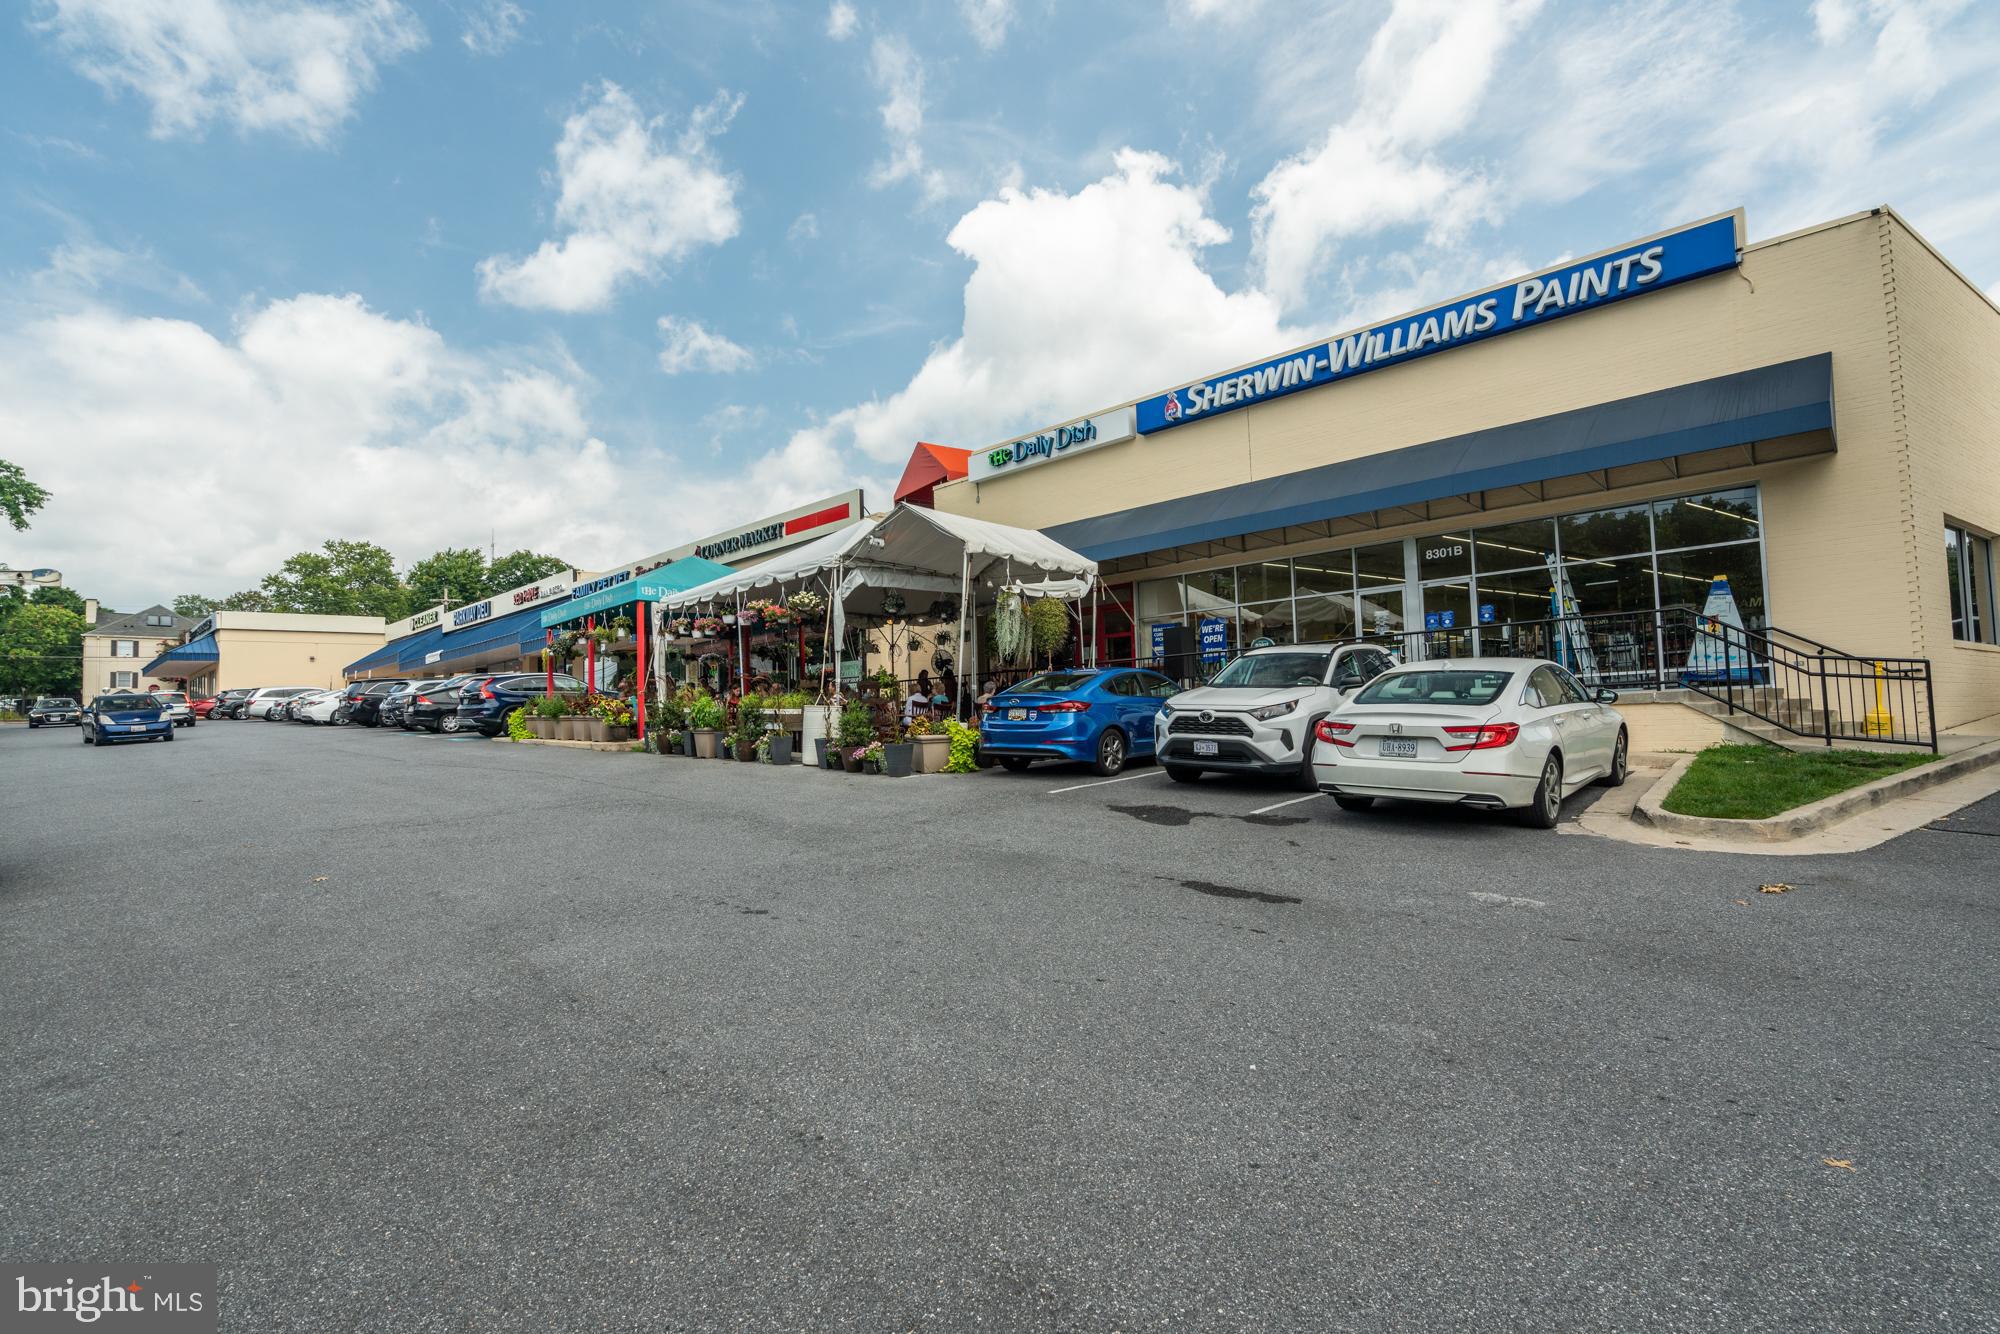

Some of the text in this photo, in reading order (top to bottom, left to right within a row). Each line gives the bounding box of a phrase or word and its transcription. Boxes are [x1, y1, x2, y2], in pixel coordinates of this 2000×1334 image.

[1186, 246, 1664, 415] SHERWIN-WILLIAMS PAINTS
[1012, 434, 1054, 462] Daily
[1055, 419, 1097, 450] Dish
[701, 521, 784, 559] CORNER MARKET
[1425, 545, 1463, 560] 8301B
[571, 579, 598, 600] FAMILY
[596, 575, 614, 592] PET
[453, 600, 492, 626] PARKWAY DELI
[1201, 623, 1224, 634] WE'RE
[1203, 634, 1223, 644] OPEN
